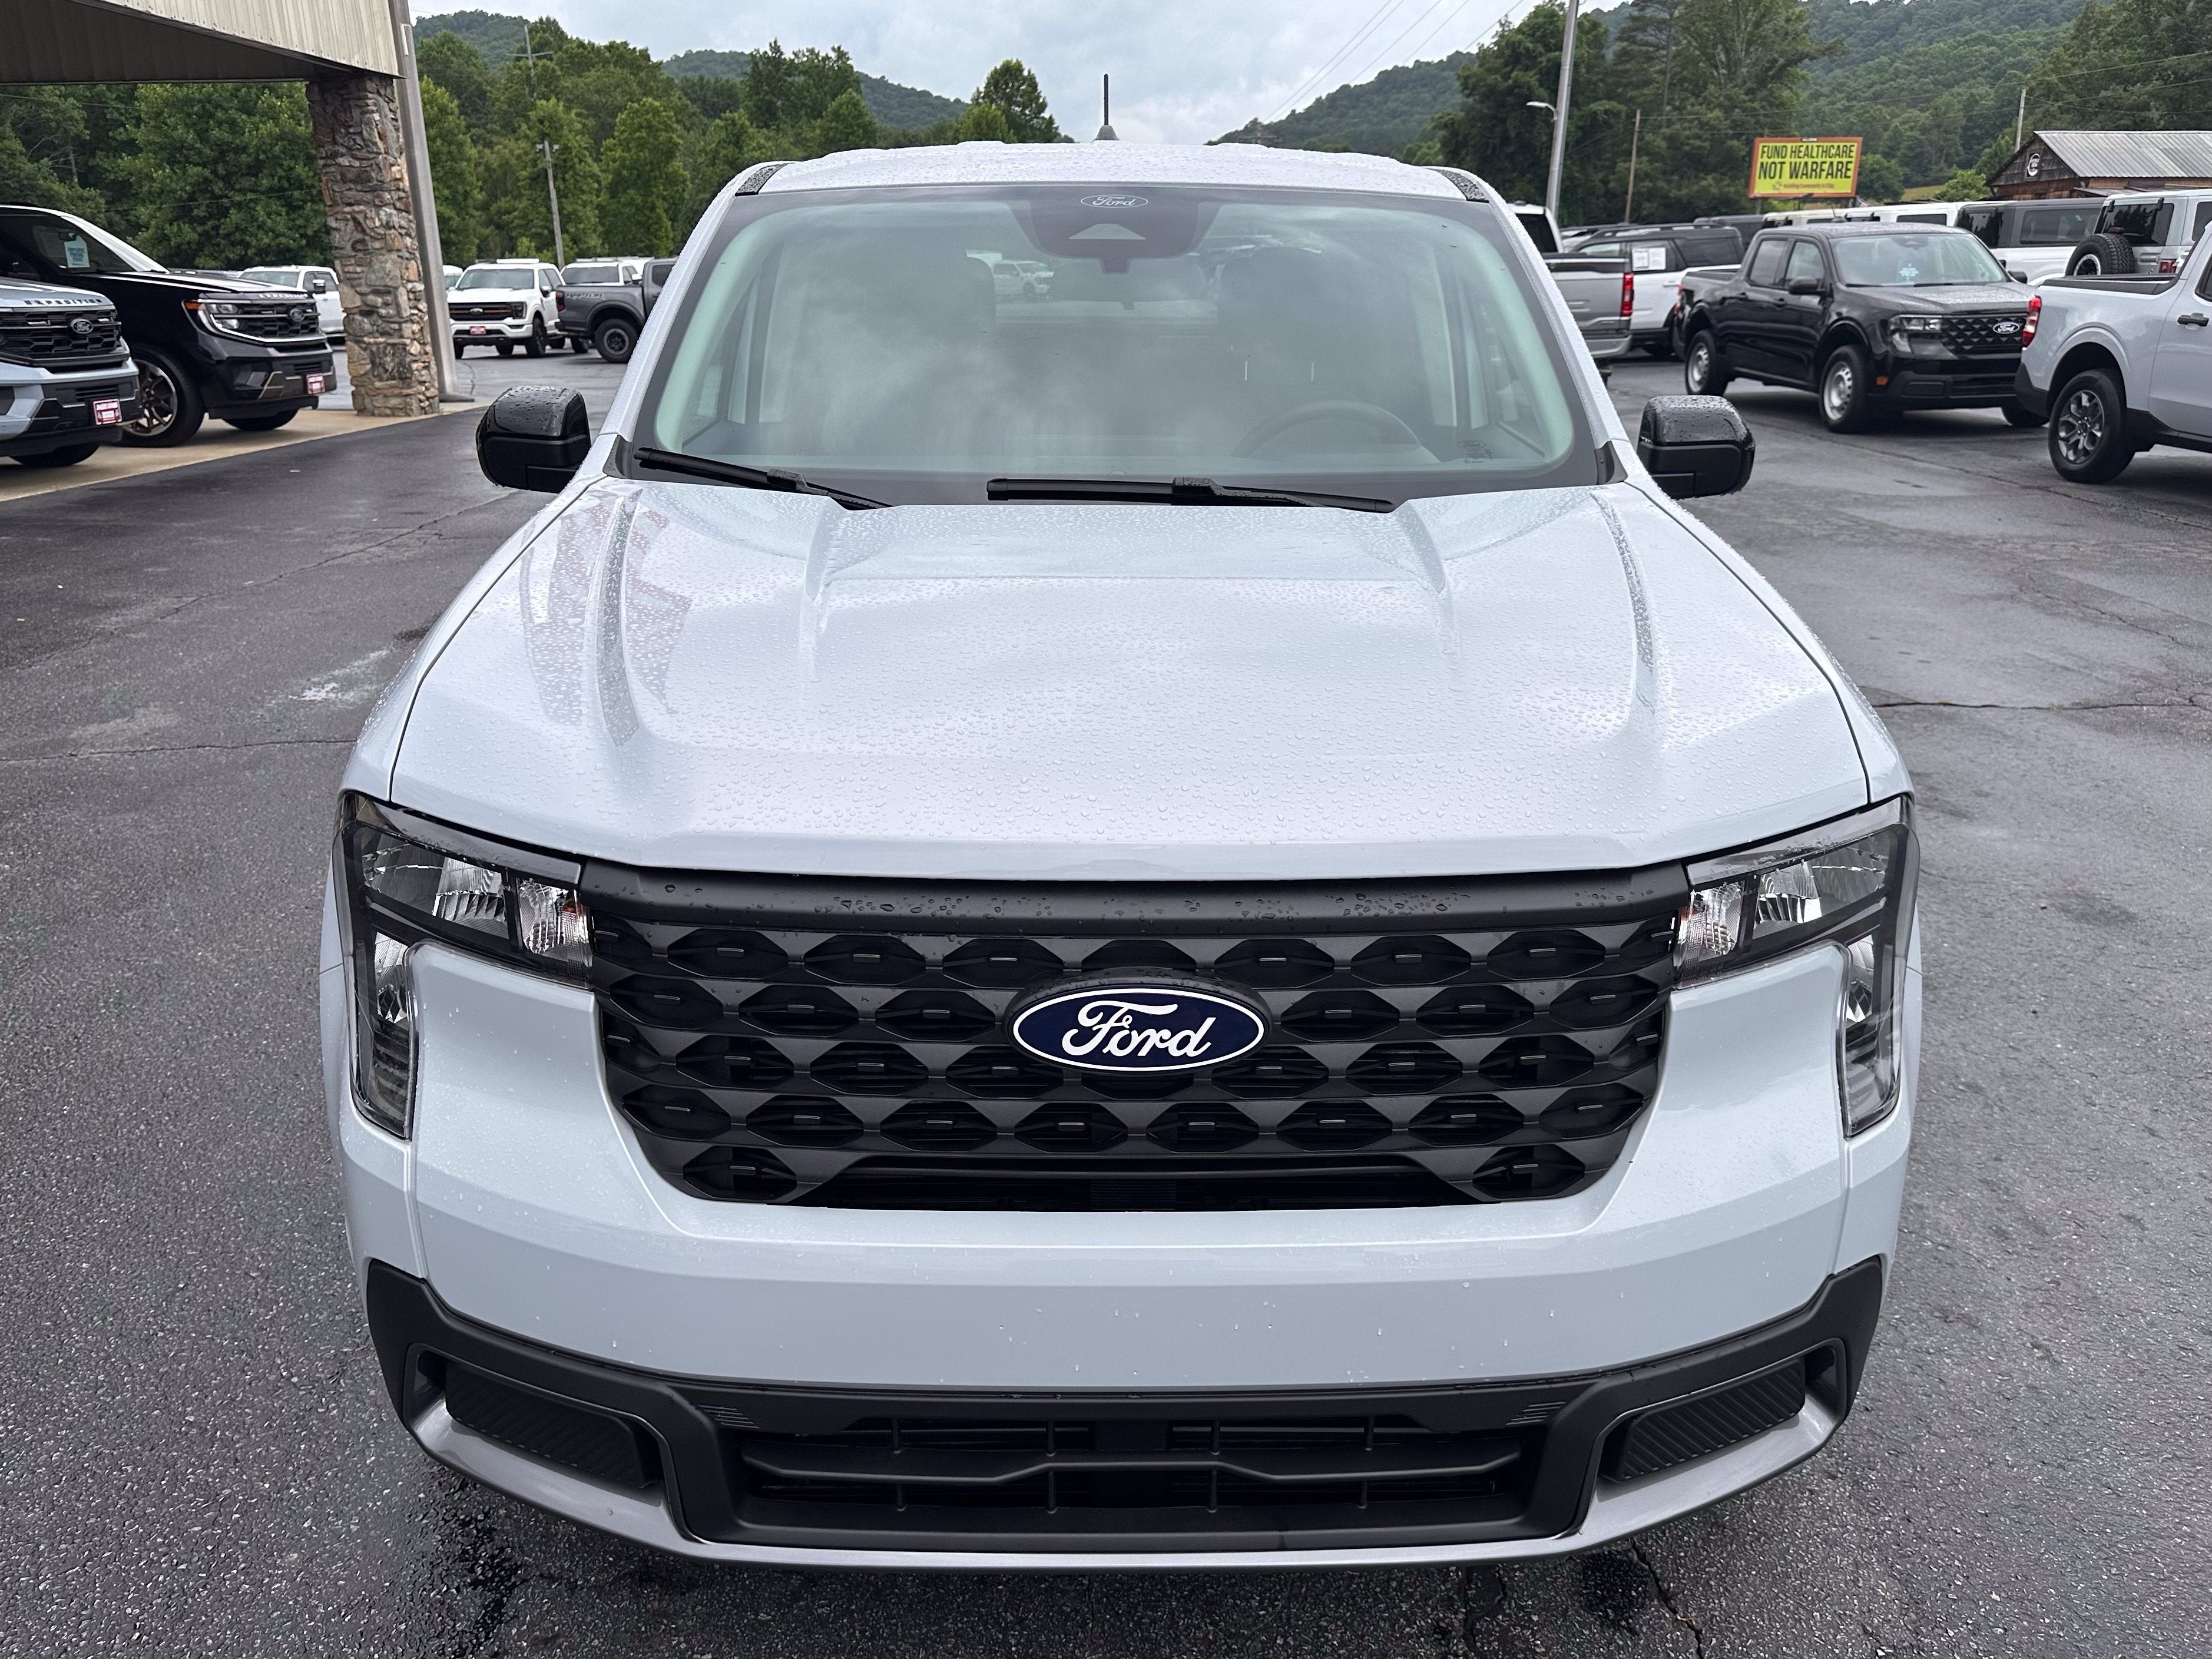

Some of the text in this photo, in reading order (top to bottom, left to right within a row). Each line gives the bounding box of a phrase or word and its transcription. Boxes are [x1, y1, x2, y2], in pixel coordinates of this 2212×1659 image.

[1761, 145, 1855, 158] FUND HEALTHCARE
[1759, 161, 1852, 179] NOT WARFARE
[1093, 196, 1136, 206] Ford
[1062, 1000, 1216, 1057] Ford
